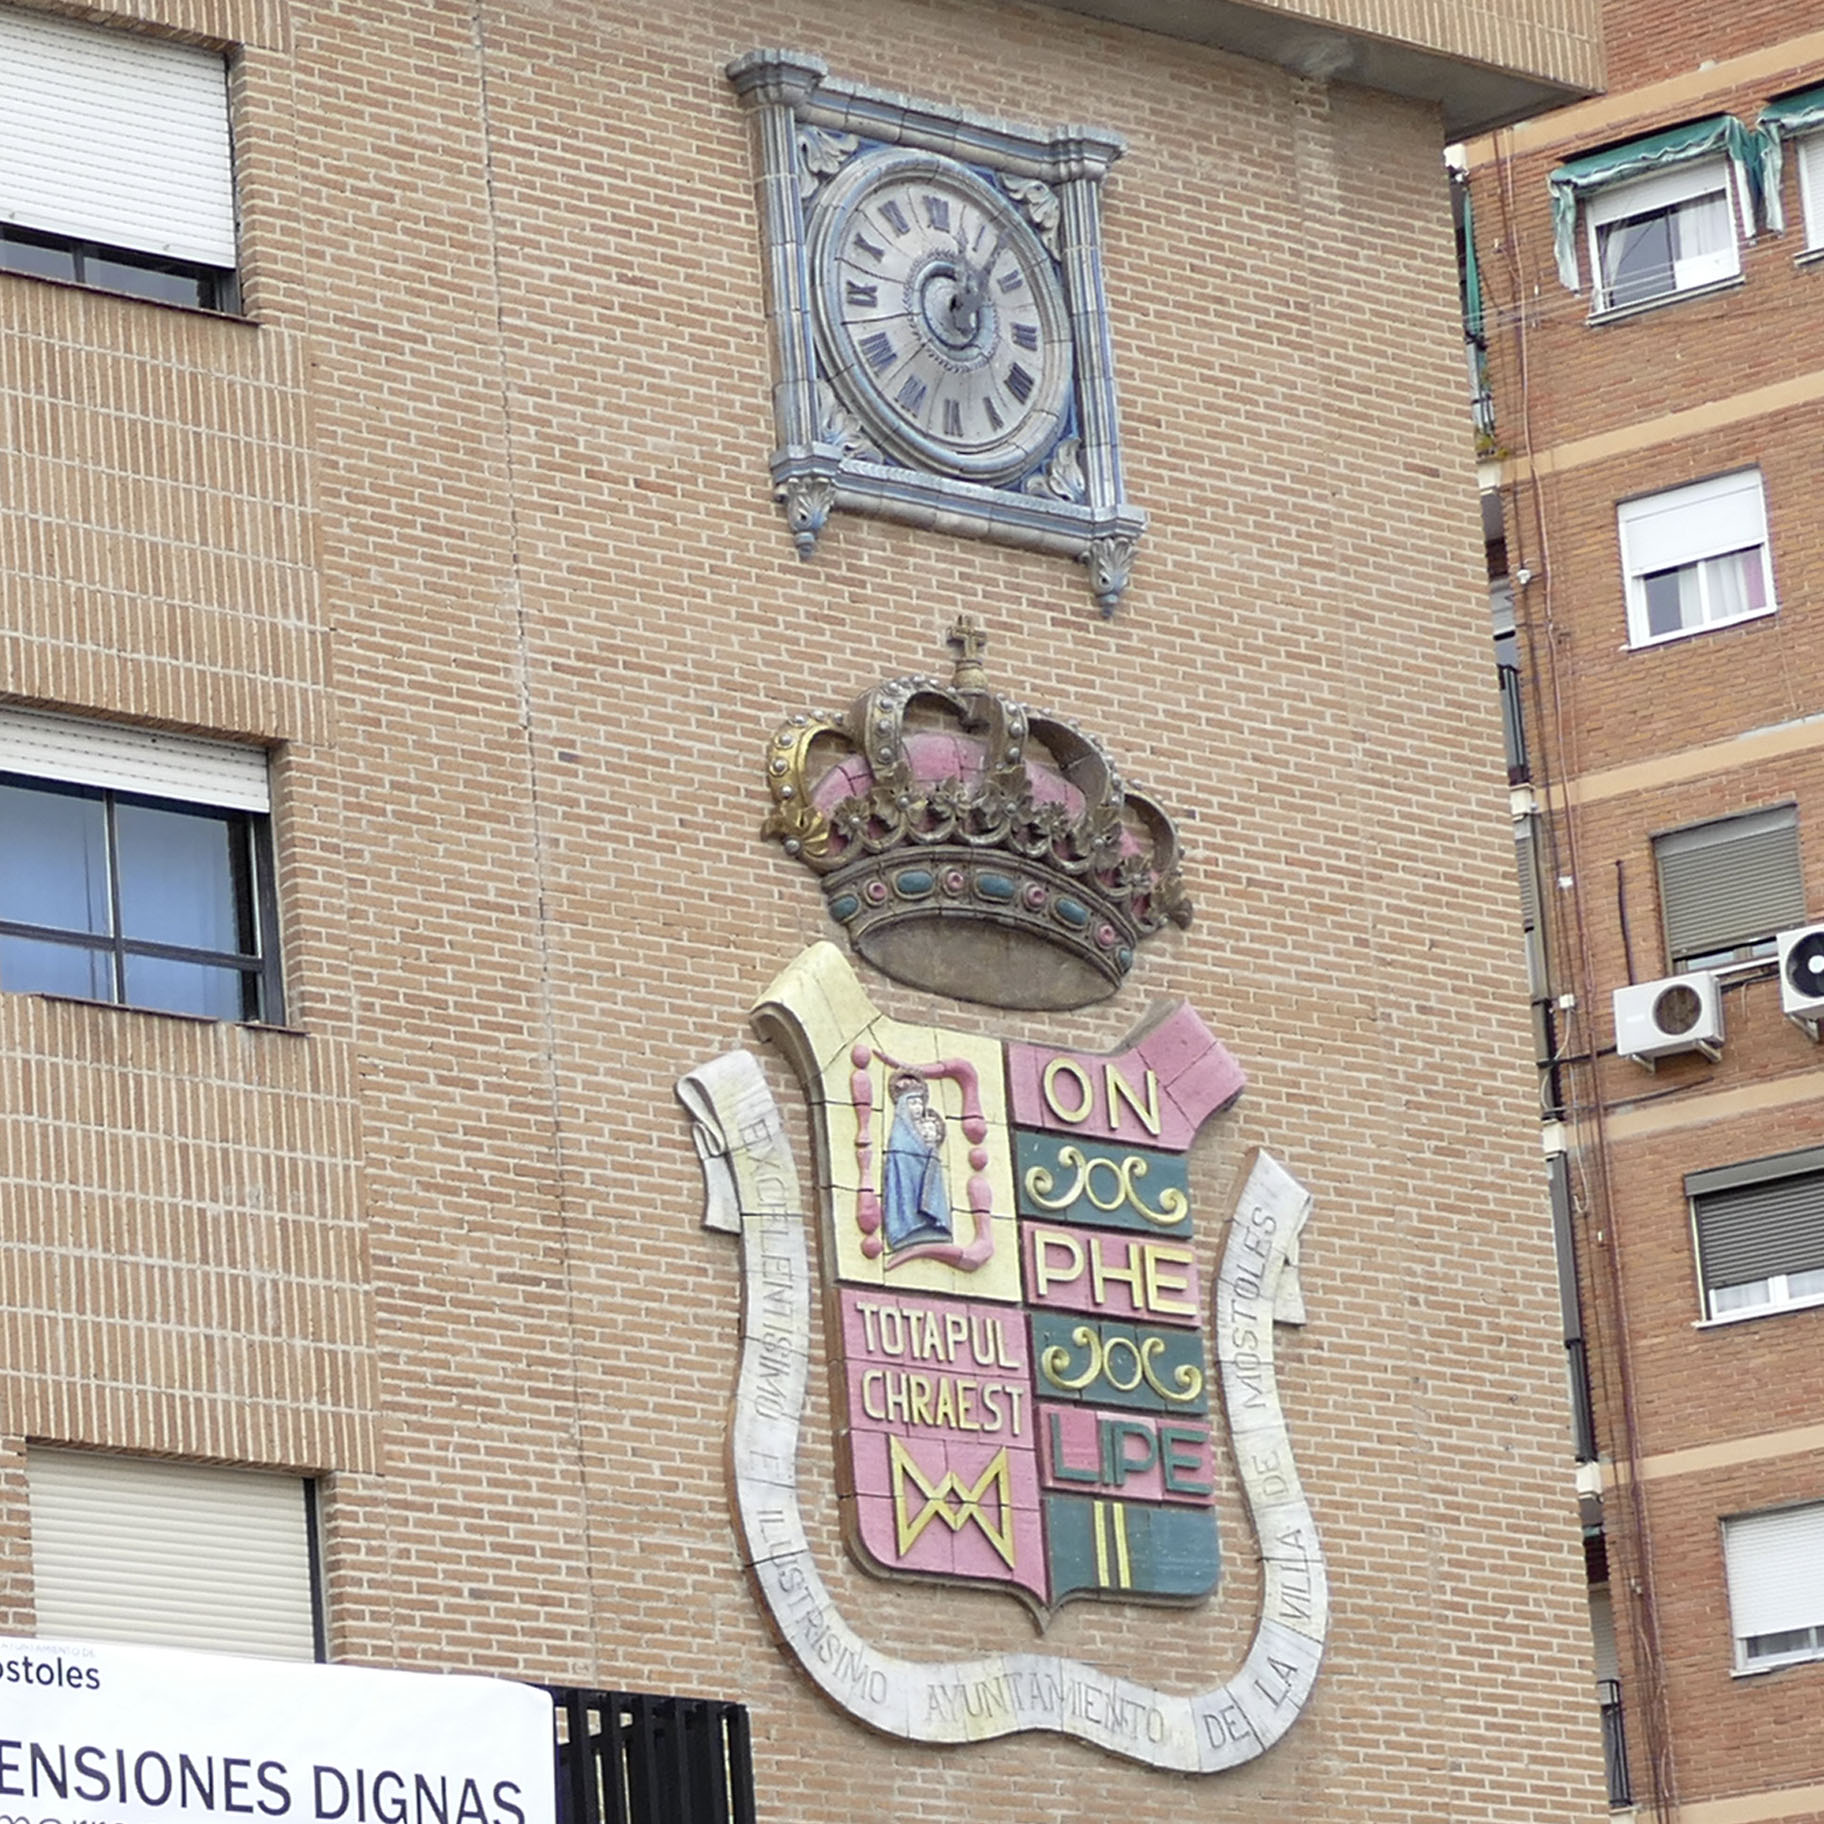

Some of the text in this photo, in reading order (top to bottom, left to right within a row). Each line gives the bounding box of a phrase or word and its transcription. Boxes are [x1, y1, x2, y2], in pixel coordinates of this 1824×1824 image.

[1042, 1057, 1162, 1138] ON
[1032, 1229, 1198, 1317] PHE
[856, 1301, 1023, 1370] TOTAPUL
[861, 1368, 1024, 1437] CHRAEST
[1048, 1411, 1214, 1496] LIPE
[1252, 1450, 1290, 1498] DE
[1276, 1527, 1312, 1622] VILLA
[925, 1671, 1165, 1744] AYUNTAMIENTO
[1253, 1656, 1299, 1709] LA
[1203, 1705, 1252, 1751] DE
